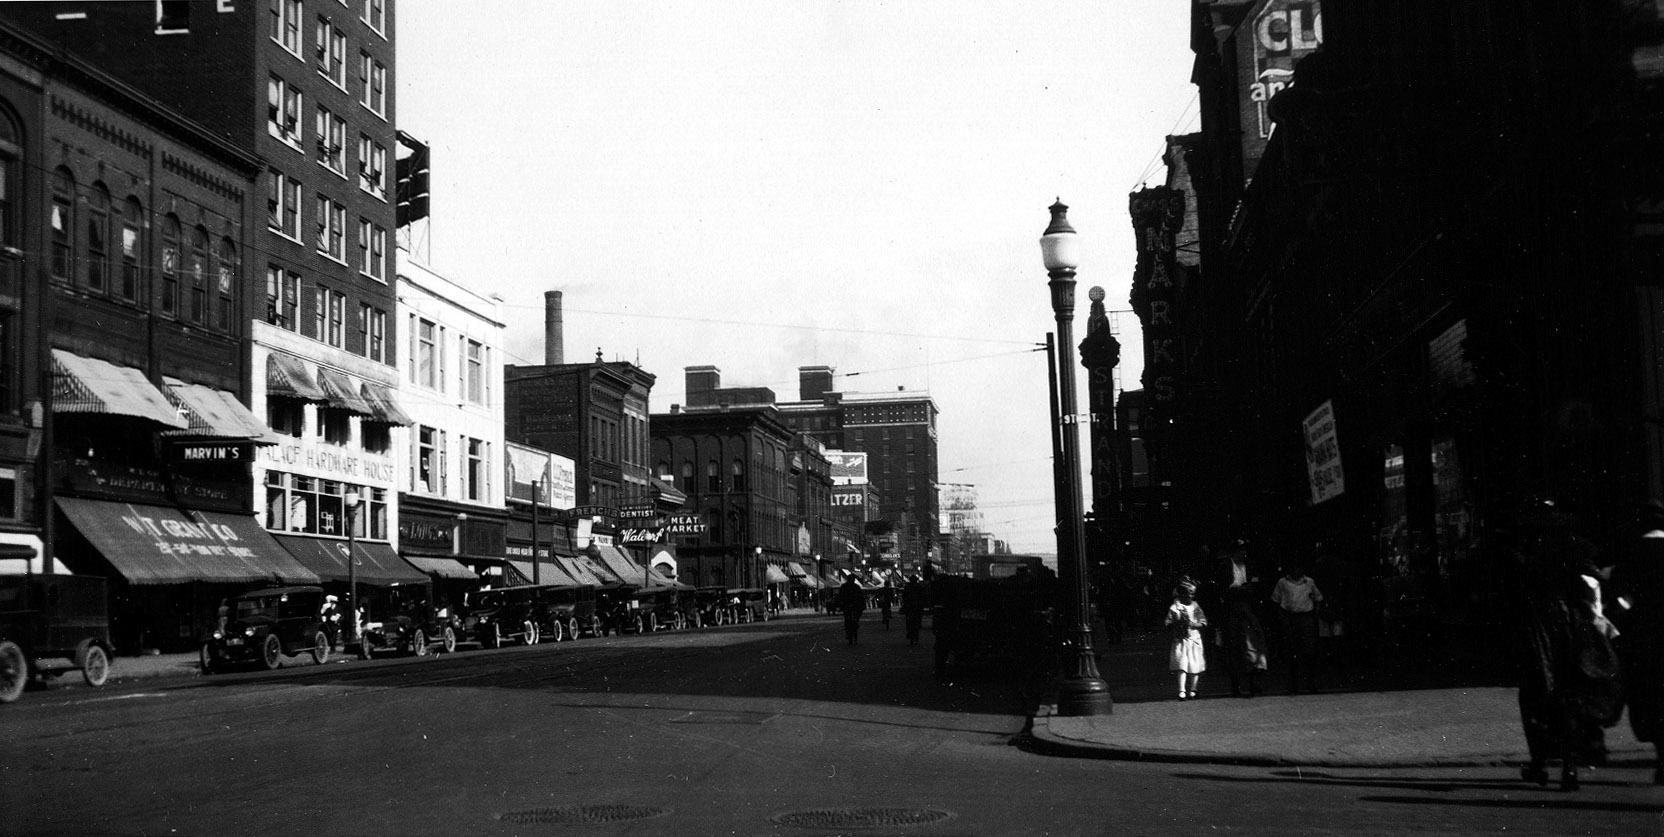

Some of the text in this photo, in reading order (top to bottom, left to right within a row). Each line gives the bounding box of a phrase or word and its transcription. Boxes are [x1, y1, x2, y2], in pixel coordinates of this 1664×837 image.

[1146, 223, 1176, 401] MARKS
[184, 447, 240, 460] MARVIN'S
[306, 448, 358, 477] HARDWARE
[363, 459, 395, 483] HOUSE
[620, 510, 655, 518] DENTIST
[671, 516, 699, 524] MEAT
[161, 519, 215, 540] GRANT
